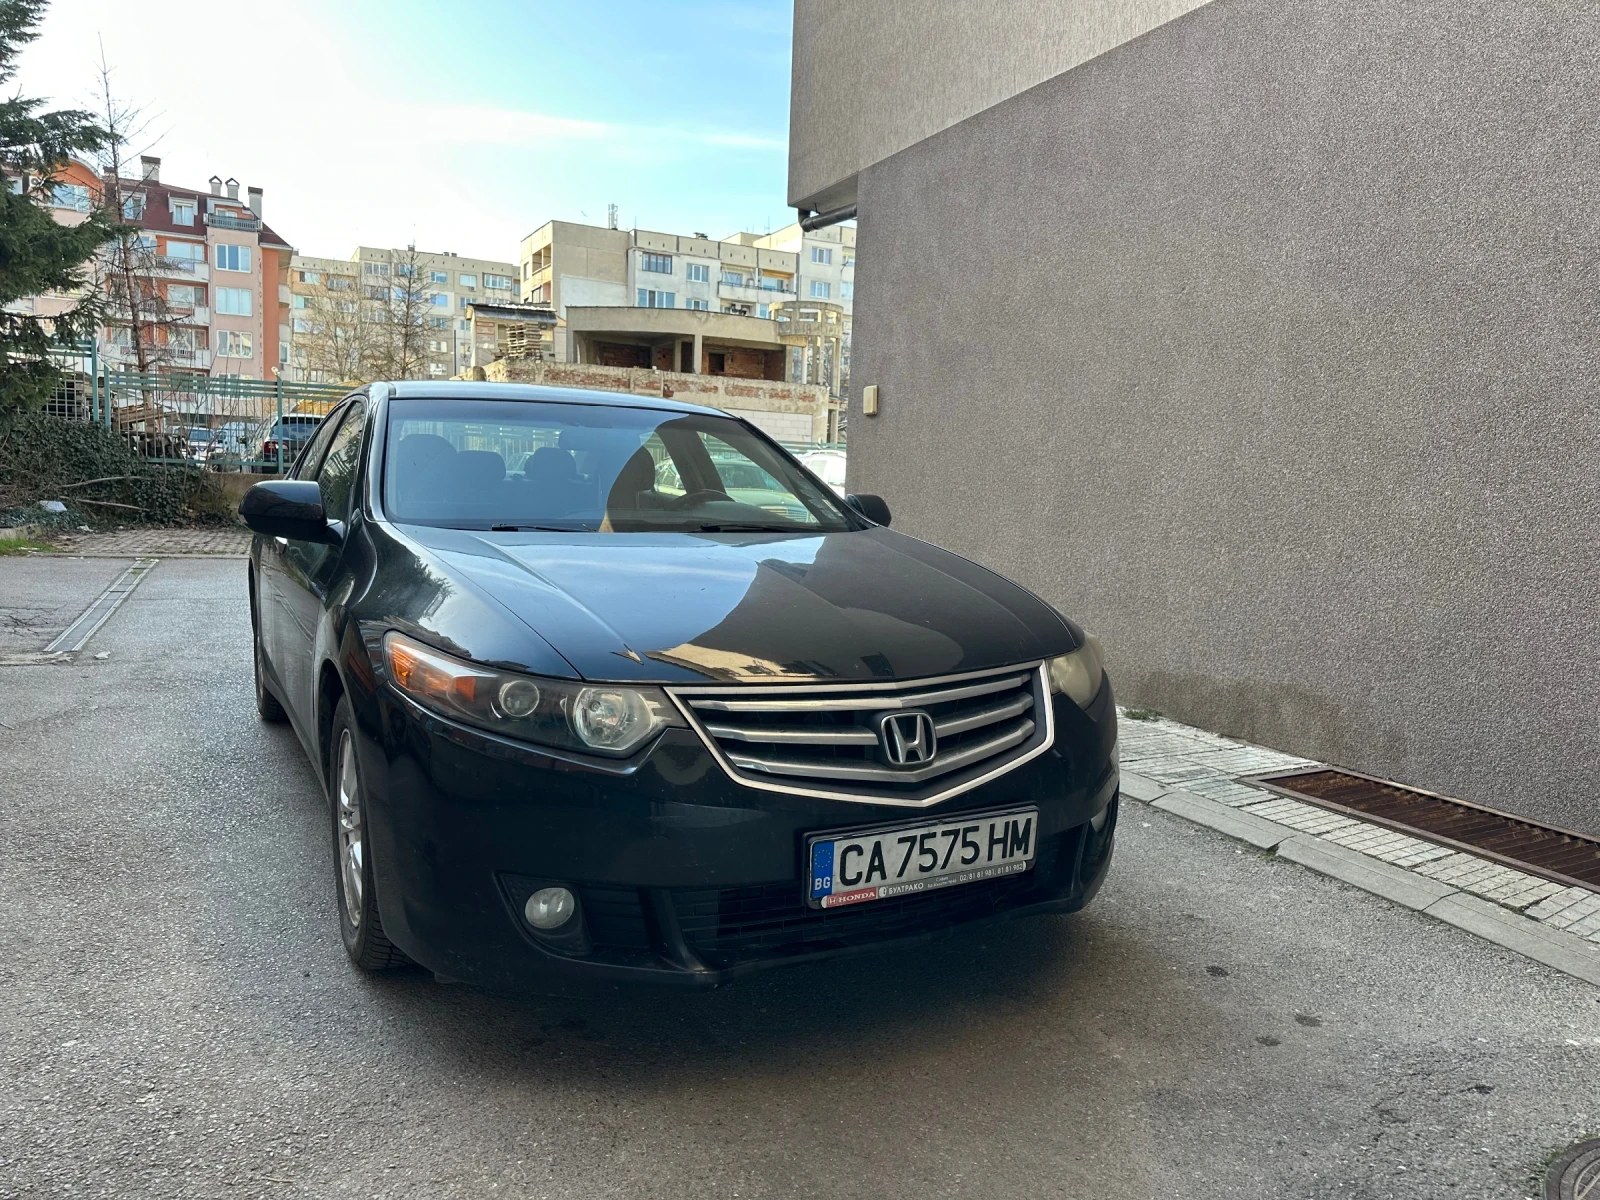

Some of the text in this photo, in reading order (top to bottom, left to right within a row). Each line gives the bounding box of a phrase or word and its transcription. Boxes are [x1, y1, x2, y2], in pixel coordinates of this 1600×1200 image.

[840, 818, 1032, 886] CA 7575 HM
[814, 877, 831, 890] BG
[888, 882, 924, 895] БУЛТРАКО
[838, 892, 876, 902] HONDA
